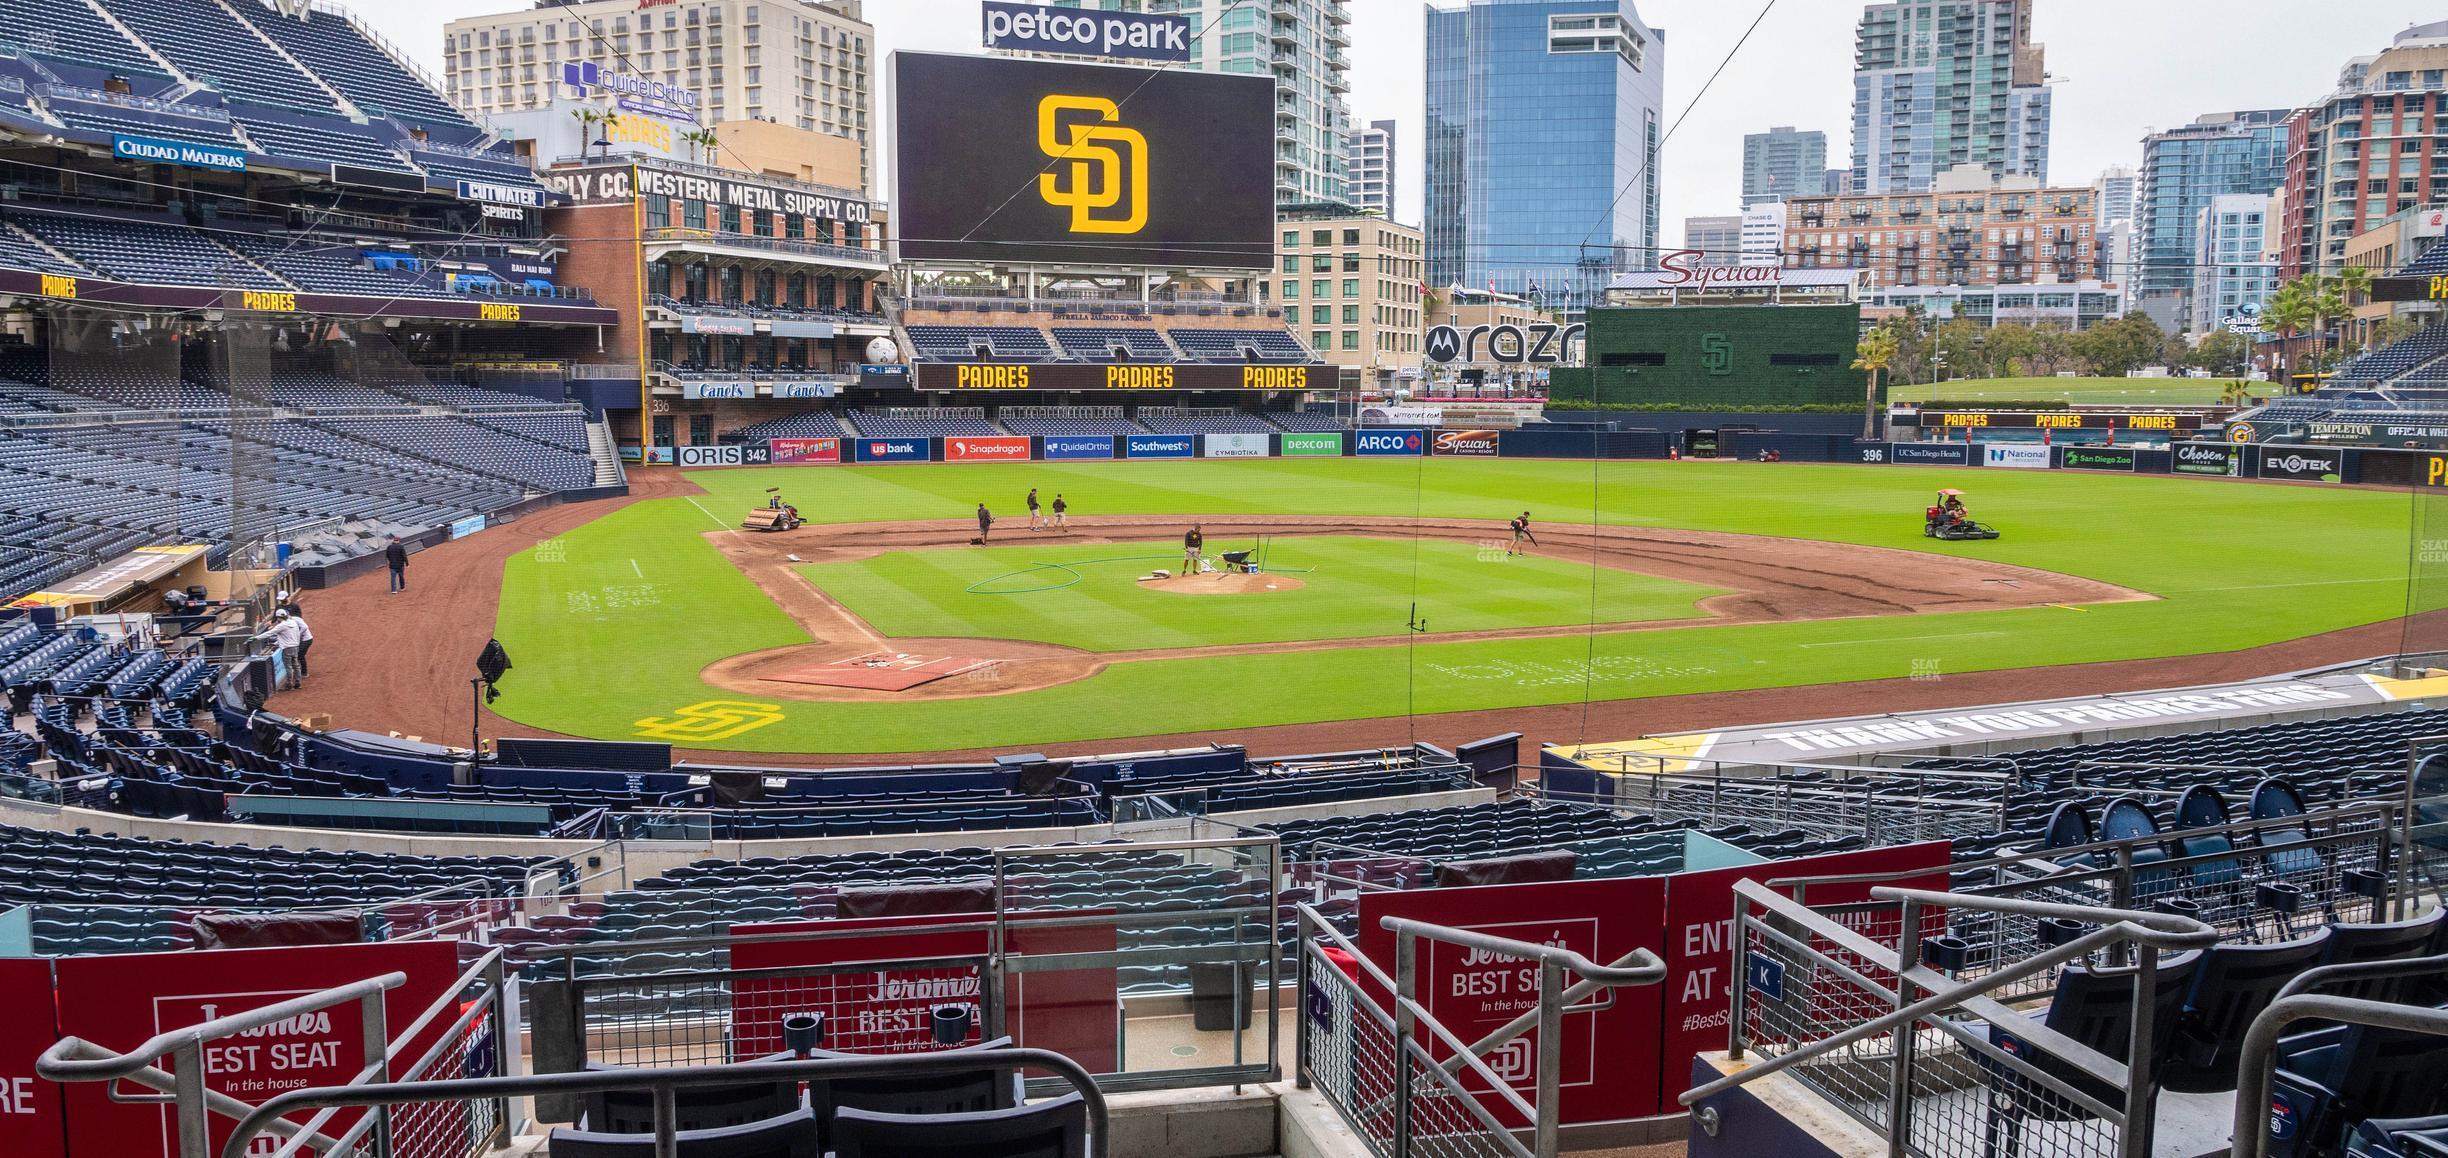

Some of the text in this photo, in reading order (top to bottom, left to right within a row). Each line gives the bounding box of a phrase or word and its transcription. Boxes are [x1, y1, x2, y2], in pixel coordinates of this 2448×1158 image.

[987, 7, 1097, 45] petco
[1103, 18, 1187, 54] park
[601, 69, 696, 107] QuidelOrtho
[607, 114, 671, 153] PADRES
[118, 141, 244, 168] CIUDAD MADERAS
[468, 182, 537, 206] CUTWATER
[599, 172, 634, 199] CO.
[637, 169, 870, 224] WESTERN METAL SUPPLY CO.
[482, 204, 524, 221] SPIRITS
[1657, 250, 1784, 294] Sycuan
[41, 273, 77, 298] PADRES
[243, 291, 296, 311] PADRES
[480, 303, 520, 321] PADRES
[1465, 323, 1586, 363] razr
[957, 365, 1029, 388] PADRES
[1106, 365, 1174, 388] PADRES
[1243, 366, 1307, 388] PADRES
[699, 383, 744, 399] Canel's
[786, 382, 825, 398] Canel's
[653, 400, 670, 412] 336
[2129, 416, 2176, 429] PADRES
[2309, 424, 2372, 436] TEMPLETON
[886, 442, 914, 453] bank
[969, 443, 1025, 455] Snapdragon
[1060, 442, 1110, 453] QuidelOrtho
[1131, 441, 1182, 452] Southwest
[1358, 436, 1405, 451] ARCO
[1436, 431, 1492, 455] Sycuan
[682, 447, 739, 465] ORIS
[746, 449, 767, 461] 342
[1863, 449, 1883, 462] 396
[1899, 449, 1909, 457] UC
[1909, 449, 1921, 457] San
[1921, 450, 1940, 459] Diego
[2007, 449, 2046, 458] National
[2079, 455, 2131, 465] San Diego Zoo
[2178, 446, 2225, 461] Chosen
[2267, 455, 2332, 473] EVOTEK
[1761, 719, 1965, 751] THANK
[1935, 710, 2063, 734] YOU
[2038, 695, 2243, 725] PADRES
[540, 889, 553, 909] 103
[1452, 966, 1570, 997] BEST SET
[1681, 967, 1717, 1004] AT
[1760, 965, 1770, 987] K
[1481, 998, 1540, 1012] In the hous
[858, 1007, 926, 1035] BEST
[270, 1041, 342, 1069] SEAT
[479, 1048, 485, 1070] J
[225, 1077, 308, 1092] In the house
